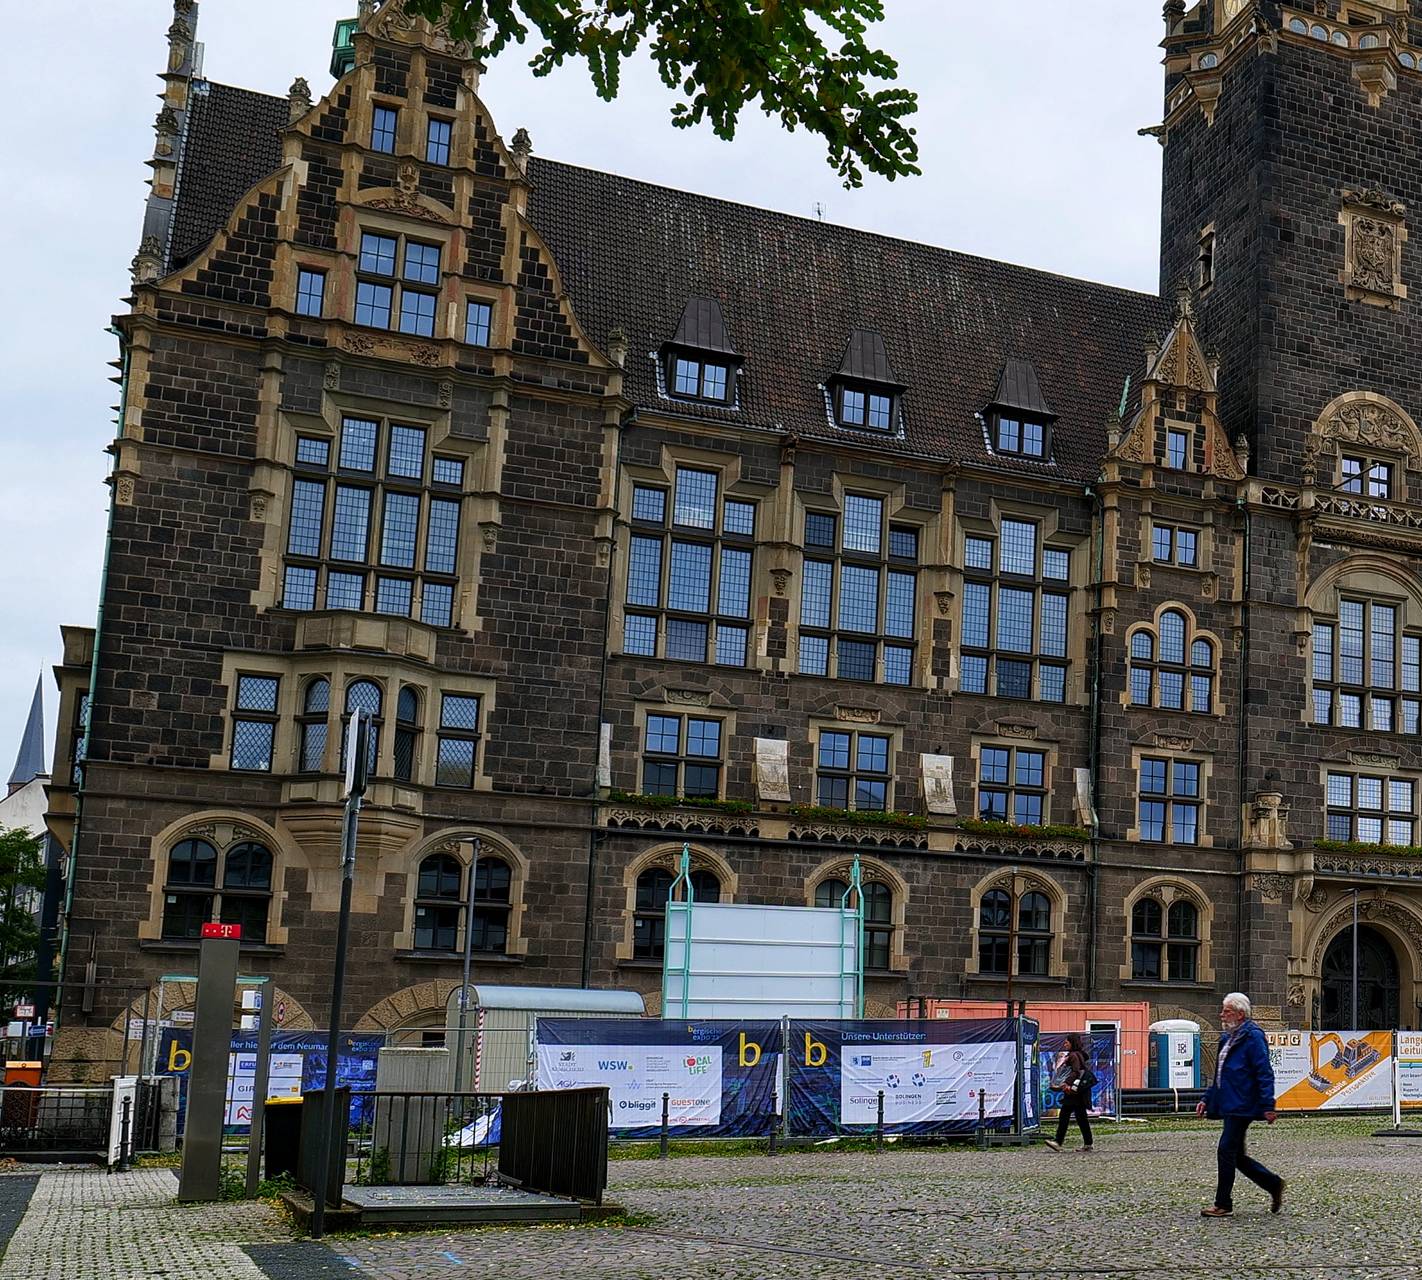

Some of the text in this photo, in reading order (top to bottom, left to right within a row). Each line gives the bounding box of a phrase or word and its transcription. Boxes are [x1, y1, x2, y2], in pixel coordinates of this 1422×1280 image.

[277, 1042, 295, 1050] dem
[873, 1032, 926, 1040] Unterstützer:
[168, 1040, 192, 1072] b
[739, 1032, 761, 1066] b
[805, 1032, 827, 1066] b
[628, 1100, 656, 1110] bliggit
